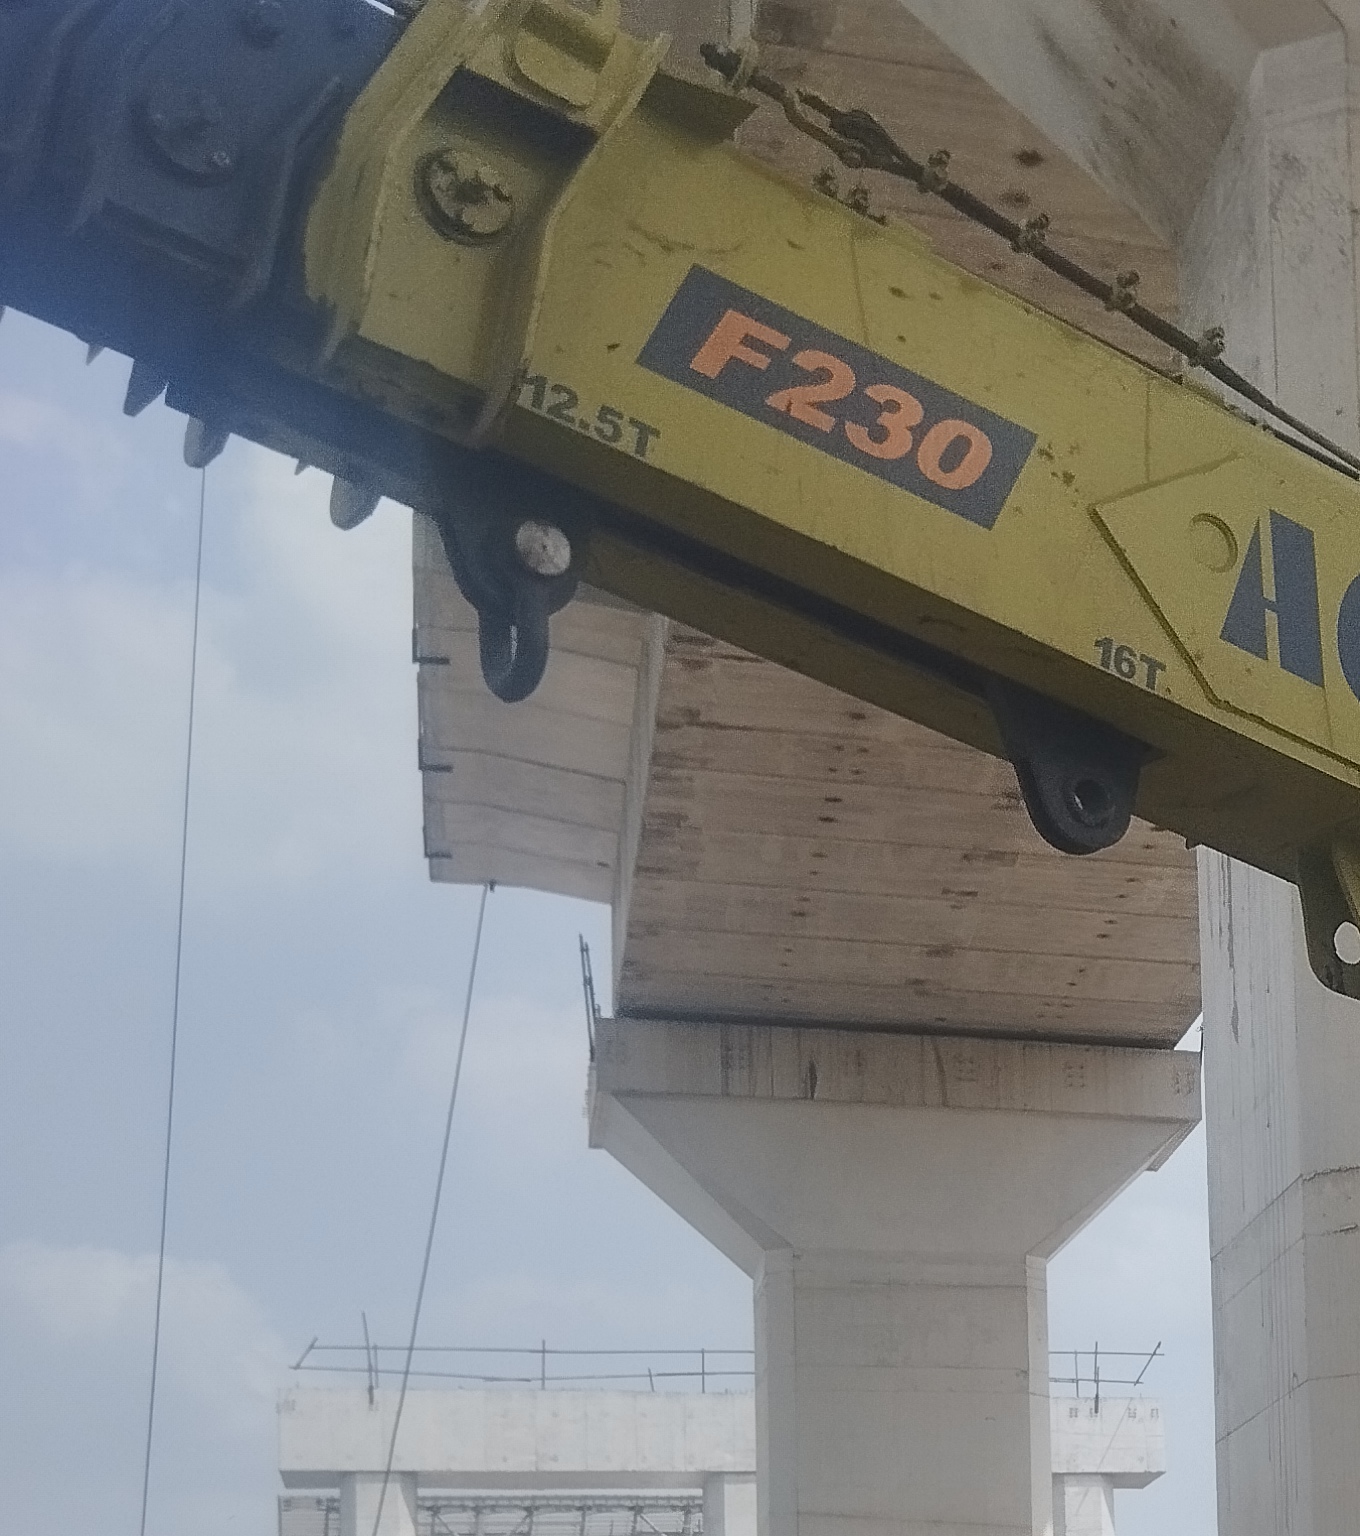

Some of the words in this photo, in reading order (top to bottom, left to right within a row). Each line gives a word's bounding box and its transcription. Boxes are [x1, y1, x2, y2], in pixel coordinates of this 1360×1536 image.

[523, 373, 662, 457] 12.5T
[689, 309, 994, 490] F230
[1094, 636, 1167, 692] 16T
